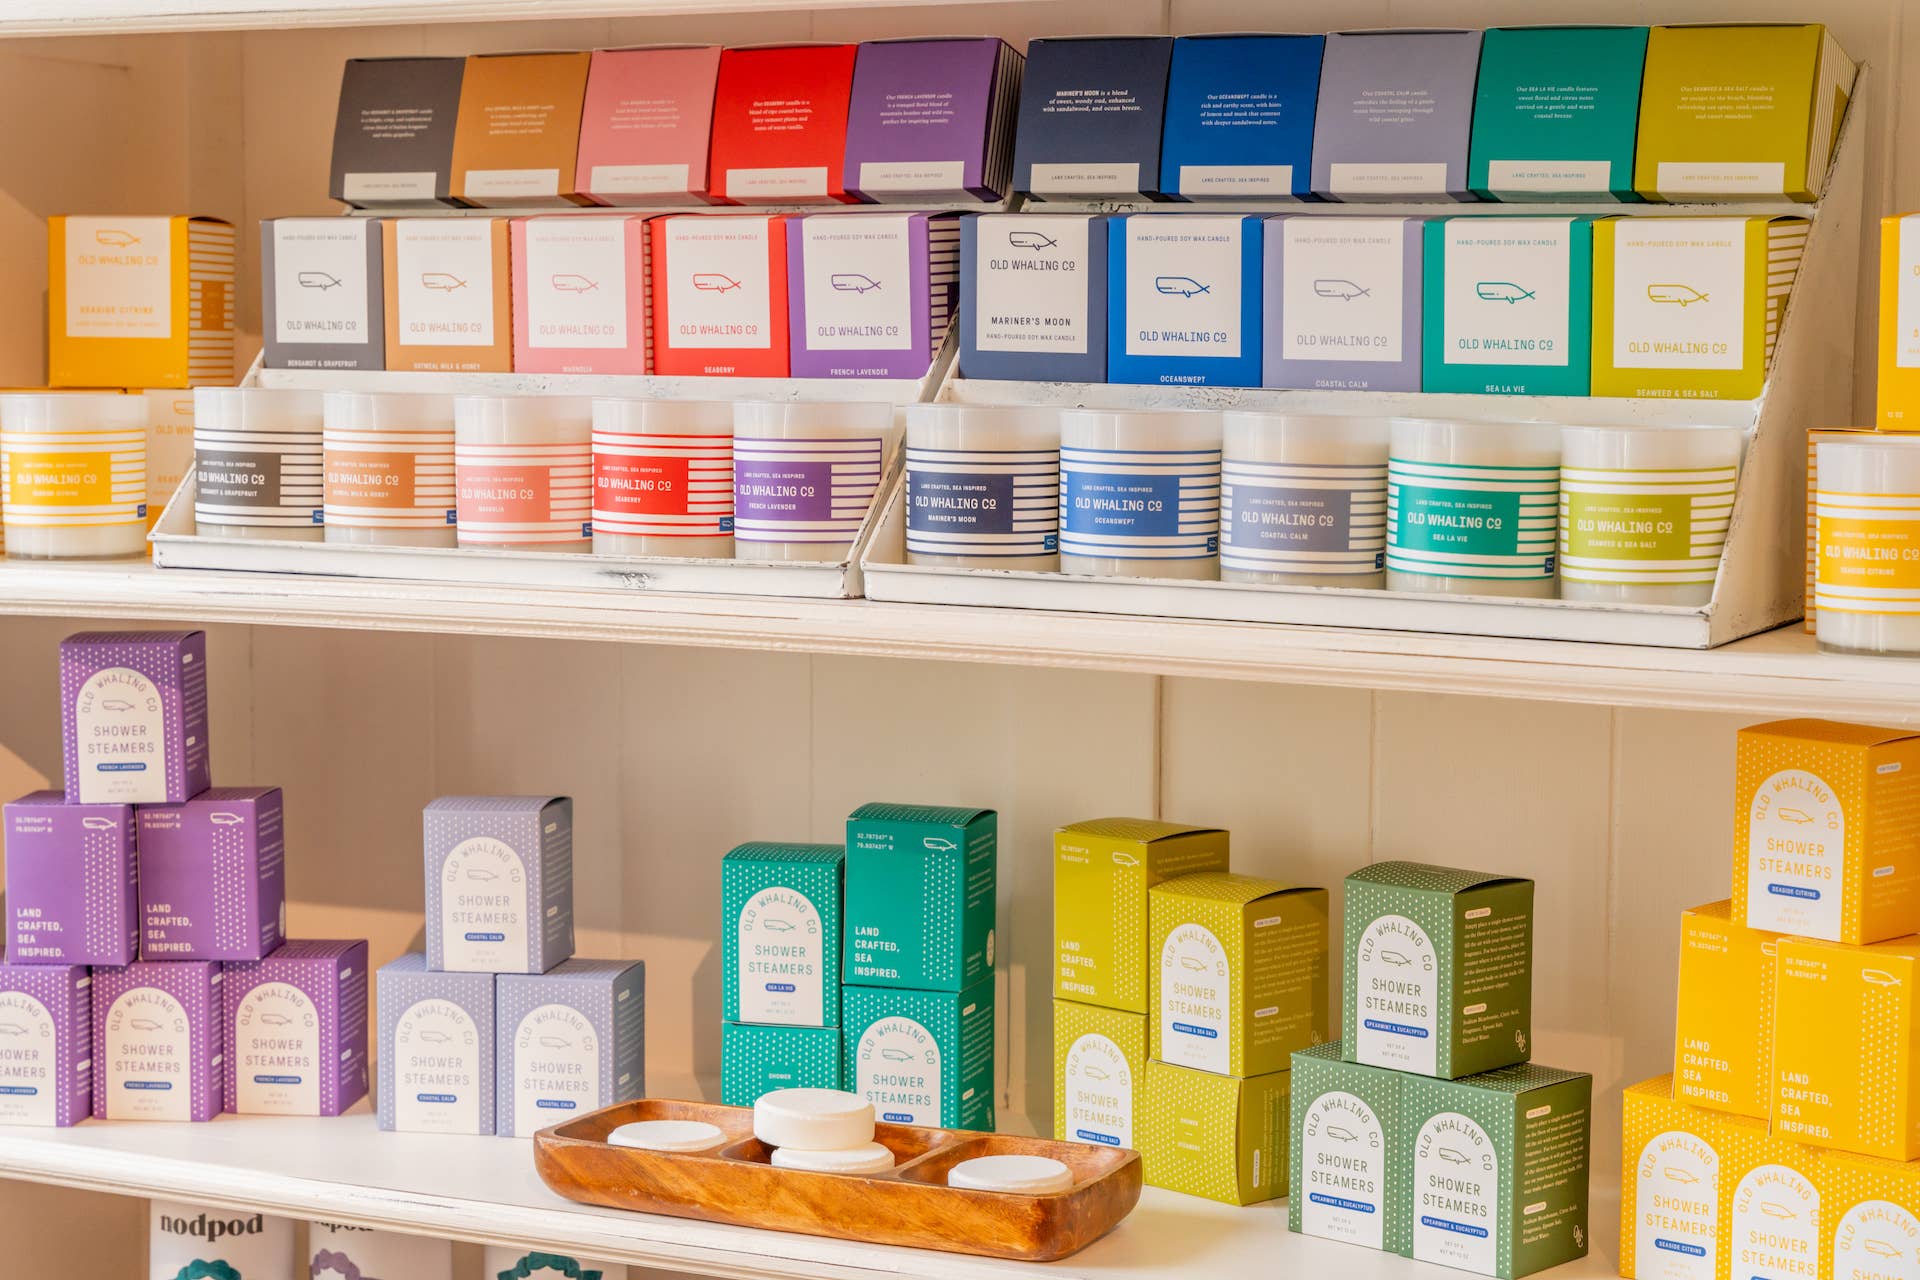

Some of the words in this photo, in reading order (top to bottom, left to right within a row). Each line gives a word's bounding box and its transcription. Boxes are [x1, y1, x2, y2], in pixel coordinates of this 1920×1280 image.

[990, 260, 1008, 270] OLD
[1012, 260, 1059, 271] WHALING
[287, 321, 302, 330] OLD
[304, 321, 343, 331] WHALING
[991, 317, 1040, 325] MARINER'S
[1044, 318, 1071, 326] MOON
[680, 325, 696, 334] OLD
[699, 325, 742, 335] WHALING
[818, 326, 835, 336] OLD
[838, 326, 883, 337] WHALING
[1140, 331, 1158, 342] OLD
[1162, 331, 1210, 343] WHALING
[1297, 335, 1316, 345] OLD
[1319, 335, 1370, 347] WHALING
[1459, 339, 1479, 350] OLD
[1483, 339, 1535, 350] WHALING
[1629, 342, 1649, 353] OLD
[1653, 342, 1708, 354] WHALING
[1160, 375, 1205, 383] OCEANSWEPT
[1315, 379, 1346, 388] COASTAL
[1348, 380, 1368, 388] CALM
[1512, 385, 1525, 393] VIE
[1637, 389, 1671, 397] SEAWEED
[1673, 389, 1679, 397] &
[1700, 390, 1719, 398] SALT
[598, 477, 609, 487] OLD
[610, 477, 654, 490] WHALING
[740, 485, 751, 495] OLD
[752, 485, 797, 496] WHALING
[916, 496, 929, 506] OLD
[931, 496, 978, 509] WHALING
[1075, 497, 1090, 508] OLD
[1093, 498, 1144, 511] WHALING
[928, 514, 957, 522] MARINER'S
[1242, 511, 1259, 522] OLD
[1262, 513, 1315, 526] WHALING
[1408, 513, 1425, 524] OLD
[1428, 514, 1482, 528] WHALING
[1577, 519, 1594, 531] OLD
[1597, 520, 1653, 533] WHALING
[81, 691, 94, 713] OLD
[96, 674, 147, 692] WHALING
[146, 697, 157, 712] CO
[94, 726, 147, 736] SHOWER
[88, 742, 155, 754] STEAMERS
[1756, 794, 1771, 821] OLD
[1772, 777, 1829, 804] WHALING
[1827, 811, 1838, 830] CO
[1767, 838, 1825, 857] SHOWER
[1759, 858, 1832, 879] STEAMERS
[458, 895, 510, 906] SHOWER
[17, 908, 41, 917] LAND
[147, 904, 171, 913] LAND
[744, 910, 757, 931] OLD
[758, 894, 808, 913] WHALING
[807, 920, 817, 935] CO
[148, 917, 192, 927] CRAFTED,
[452, 913, 517, 924] STEAMERS
[17, 922, 63, 932] CRAFTED,
[855, 927, 879, 936] LAND
[18, 935, 35, 944] SEA
[148, 930, 165, 939] SEA
[148, 943, 194, 952] INSPIRED.
[755, 945, 807, 957] SHOWER
[855, 940, 900, 952] CRAFTED,
[1061, 940, 1080, 951] LAND
[1362, 938, 1375, 962] OLD
[1376, 922, 1424, 948] WHALING
[1422, 954, 1432, 972] CO
[18, 948, 64, 957] INSPIRED.
[855, 953, 872, 963] SEA
[1061, 953, 1097, 968] CRAFTED,
[748, 962, 813, 975] STEAMERS
[854, 966, 900, 978] INSPIRED.
[1061, 967, 1075, 978] SEA
[1061, 981, 1097, 995] INSPIRED.
[1174, 982, 1216, 1000] SHOWER
[1372, 978, 1421, 997] SHOWER
[1168, 998, 1222, 1020] STEAMERS
[1365, 996, 1428, 1018] STEAMERS
[1366, 1021, 1391, 1031] SPEARMINT
[1397, 1026, 1427, 1036] EUCALYPTUS
[122, 1044, 173, 1056] SHOWER
[251, 1038, 303, 1050] SHOWER
[862, 1038, 875, 1060] OLD
[876, 1023, 926, 1044] WHALING
[924, 1050, 936, 1065] CO
[1684, 1038, 1710, 1052] LAND
[115, 1061, 181, 1073] STEAMERS
[246, 1055, 310, 1067] STEAMERS
[411, 1056, 463, 1068] SHOWER
[1684, 1054, 1732, 1072] CRAFTED,
[530, 1062, 582, 1074] SHOWER
[405, 1073, 470, 1085] STEAMERS
[873, 1074, 924, 1088] SHOWER
[1683, 1069, 1701, 1081] SEA
[1781, 1072, 1808, 1084] LAND
[524, 1079, 589, 1092] STEAMERS
[867, 1091, 931, 1106] STEAMERS
[1682, 1084, 1732, 1103] INSPIRED.
[1781, 1087, 1833, 1106] CRAFTED,
[1781, 1104, 1800, 1116] SEA
[1307, 1113, 1320, 1136] OLD
[1321, 1099, 1370, 1124] WHALING
[1369, 1131, 1379, 1148] CO
[1780, 1121, 1832, 1138] INSPIRED.
[1317, 1152, 1368, 1173] SHOWER
[1311, 1171, 1374, 1193] STEAMERS
[1429, 1175, 1480, 1196] SHOWER
[1423, 1193, 1487, 1217] STEAMERS
[1654, 1194, 1710, 1216] SHOWER
[159, 1213, 264, 1242] nodpod
[1646, 1213, 1716, 1238] STEAMERS
[1750, 1231, 1808, 1254] SHOWER
[1742, 1250, 1816, 1276] STEAMERS
